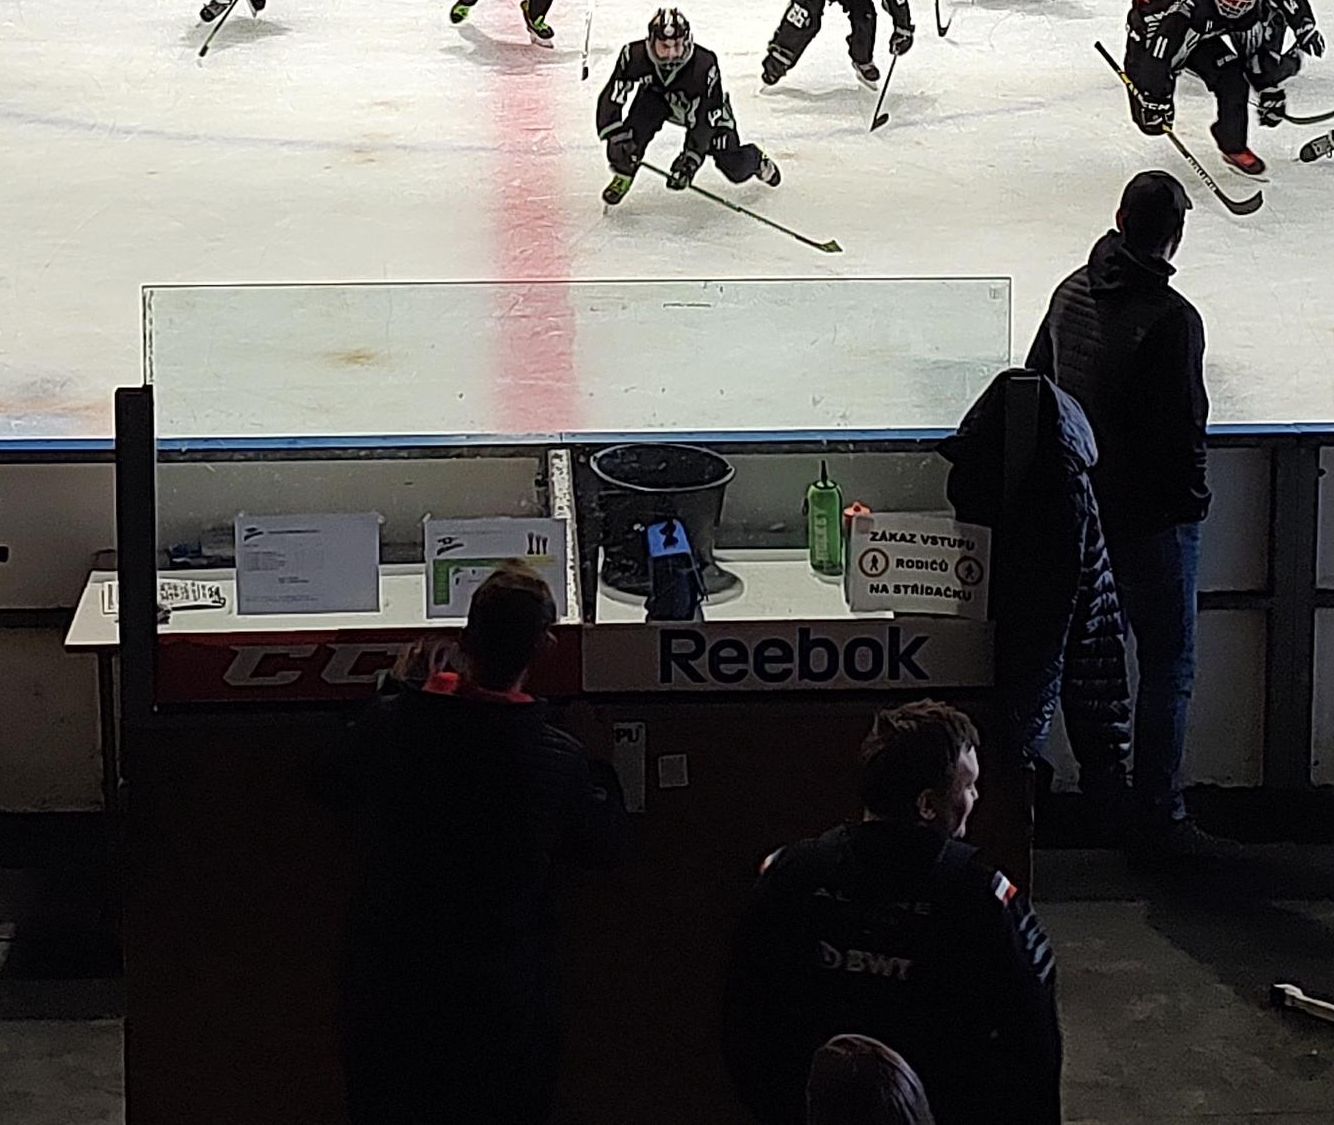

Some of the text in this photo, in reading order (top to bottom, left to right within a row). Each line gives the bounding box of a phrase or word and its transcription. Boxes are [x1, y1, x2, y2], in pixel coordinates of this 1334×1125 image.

[870, 531, 975, 551] ZÁKAZ VSTUPU
[895, 559, 949, 572] RODIČŮ
[869, 584, 972, 602] NA STŘÍDAČKU
[658, 626, 931, 685] Reebok
